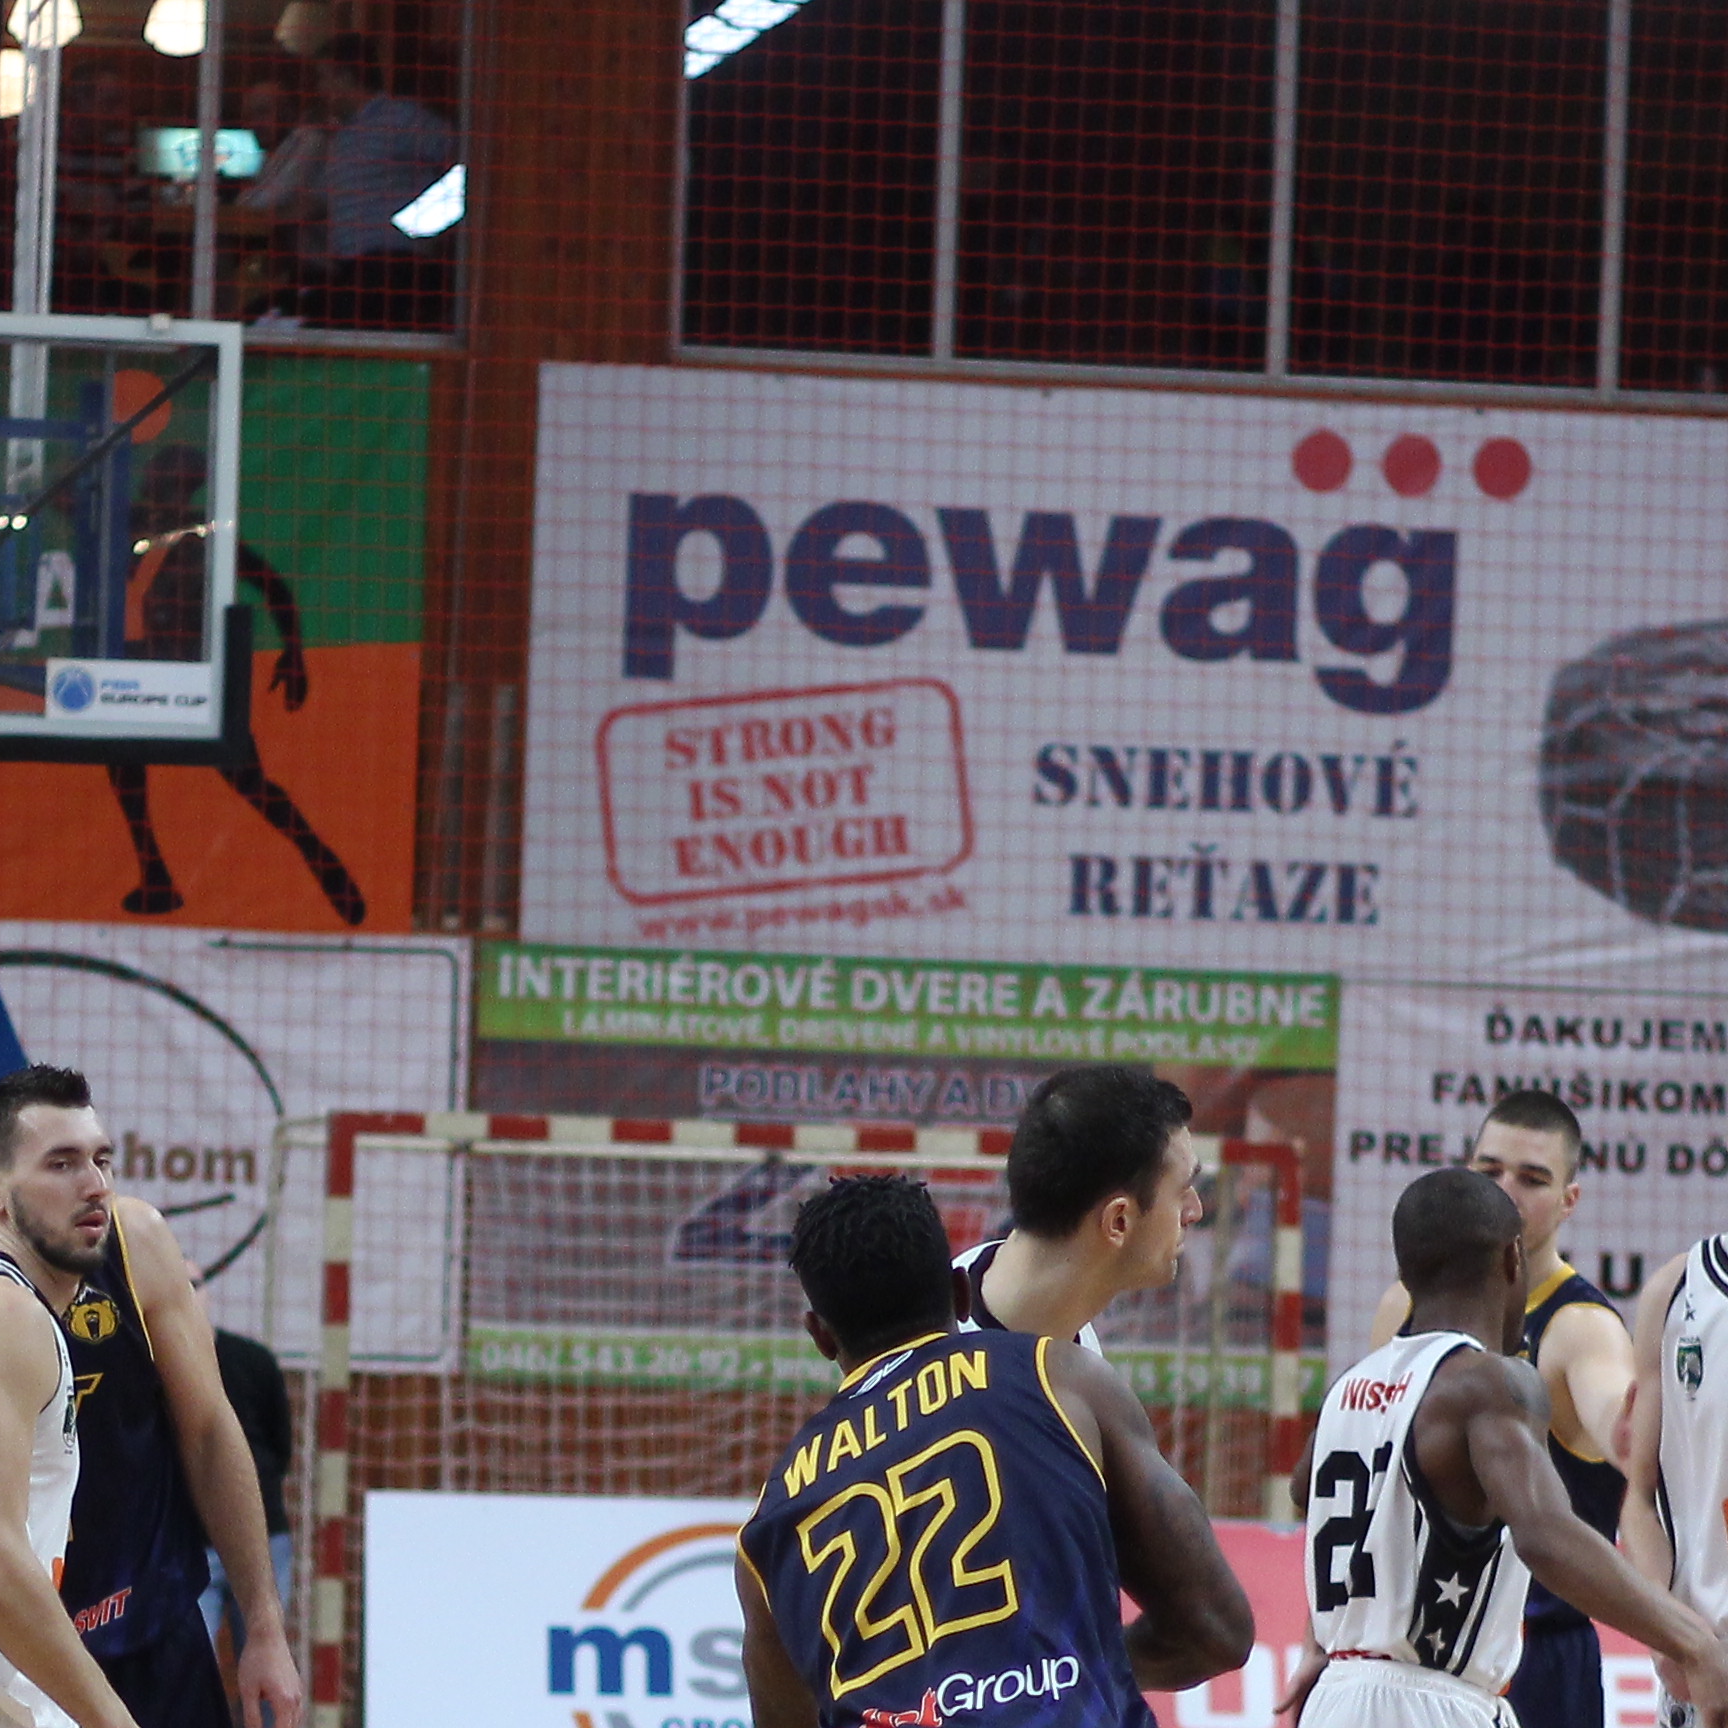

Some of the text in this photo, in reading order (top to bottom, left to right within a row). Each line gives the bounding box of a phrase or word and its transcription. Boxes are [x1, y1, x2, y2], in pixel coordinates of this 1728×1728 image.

[663, 708, 898, 772] STRONG
[686, 763, 876, 824] IS NOT
[1031, 738, 1421, 822] SNEHOVÉ
[670, 815, 912, 878] ENOUGH
[1065, 843, 1382, 927] REŤAZE
[496, 955, 1329, 1031] INTERIÉROVÉ DVERE A ZÁRUBNE
[699, 1063, 935, 1118] PODLAHY
[781, 1348, 990, 1499] WALTON
[796, 1429, 1020, 1701] 22
[547, 1623, 746, 1699] ms
